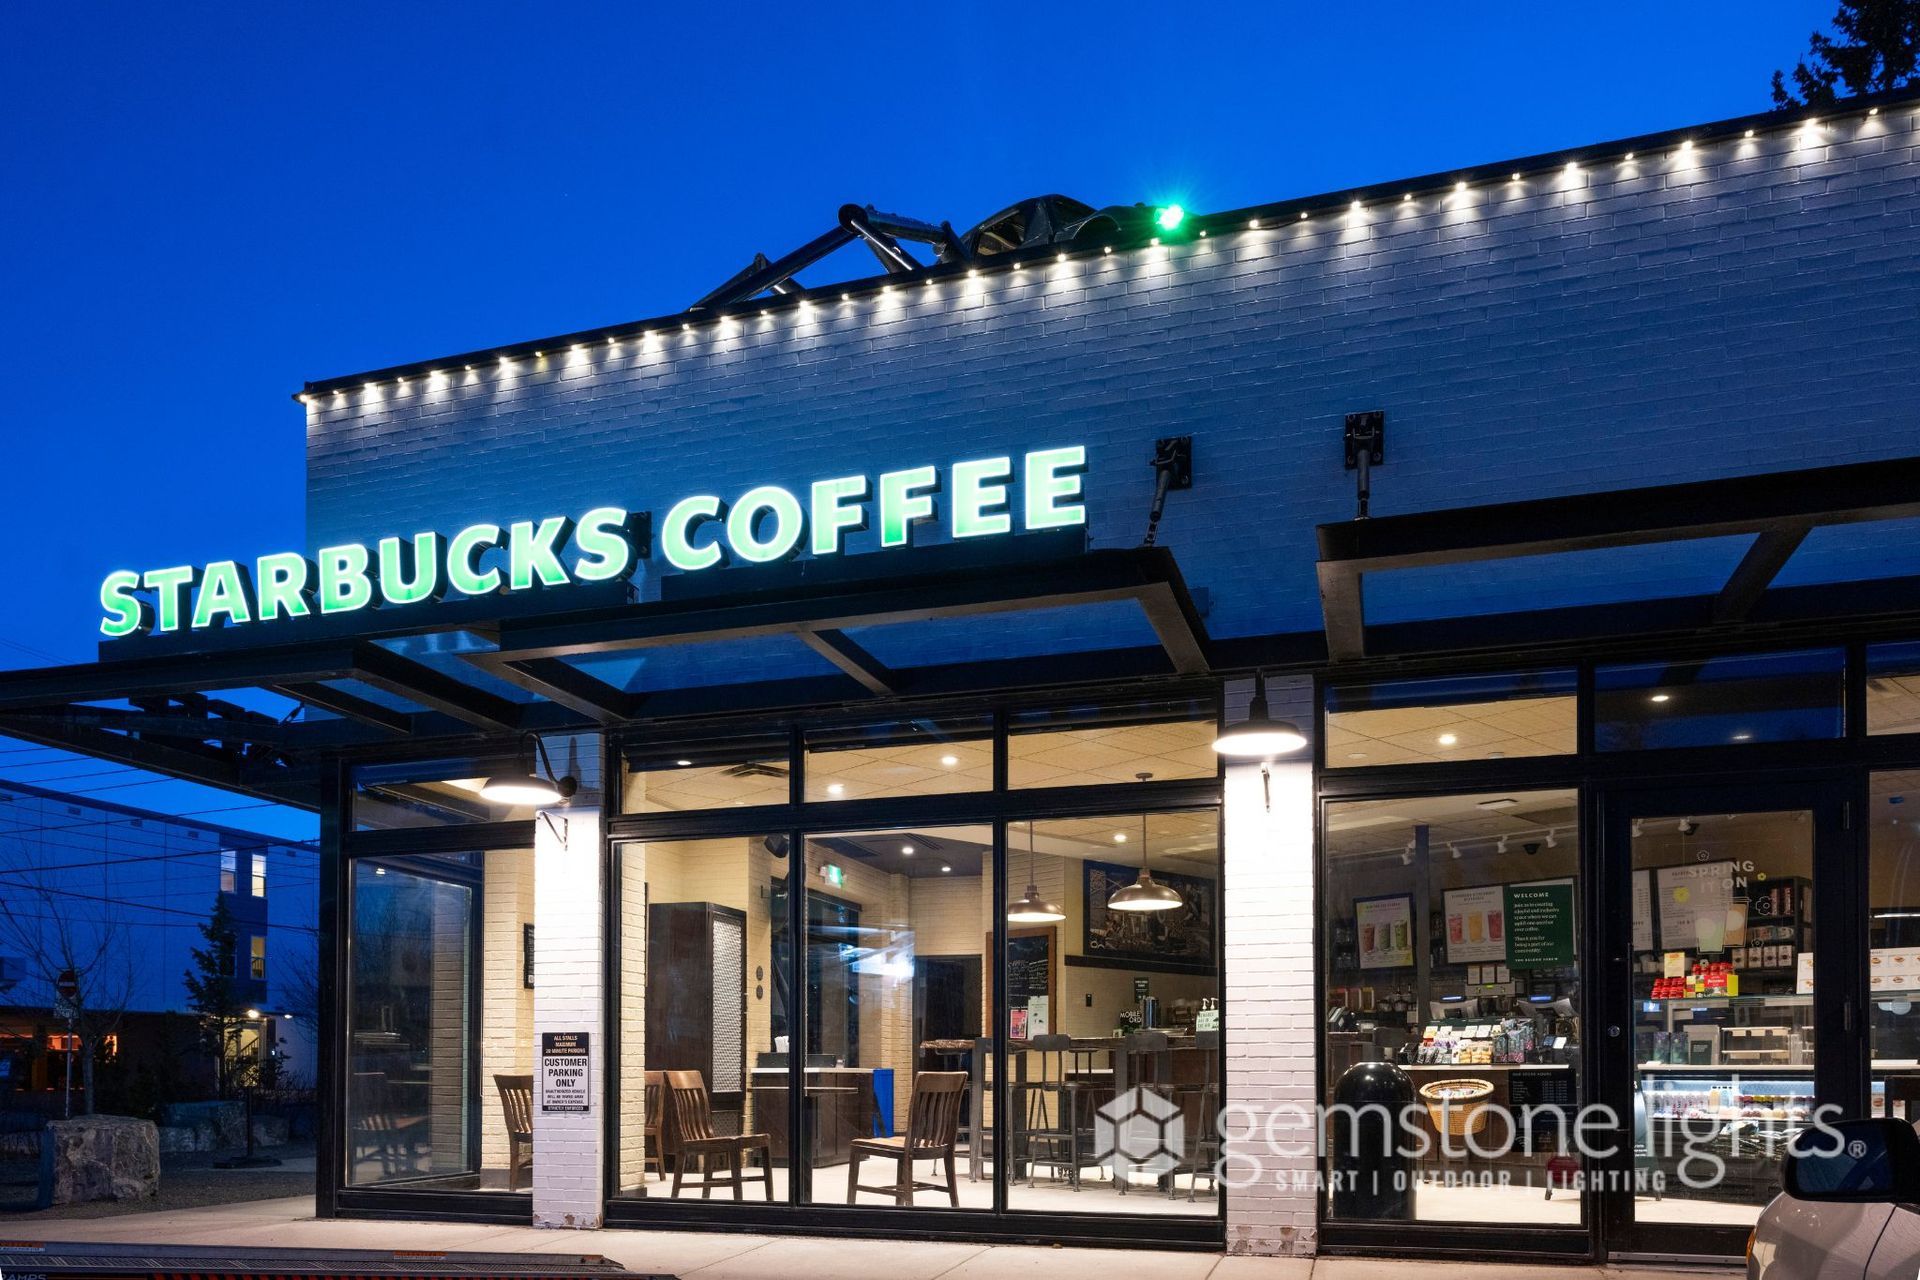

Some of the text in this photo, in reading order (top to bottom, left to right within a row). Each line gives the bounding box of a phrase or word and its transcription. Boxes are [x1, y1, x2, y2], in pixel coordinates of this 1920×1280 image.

[99, 444, 1087, 638] STARBUCKS COFFEE
[1688, 860, 1755, 879] SPRING
[1700, 876, 1748, 894] IT ON
[1119, 1010, 1141, 1018] MOBILE
[1128, 1016, 1142, 1024] ORD
[544, 1058, 588, 1067] CUSTOMER
[548, 1068, 584, 1077] PARKING
[555, 1079, 576, 1088] ONLY
